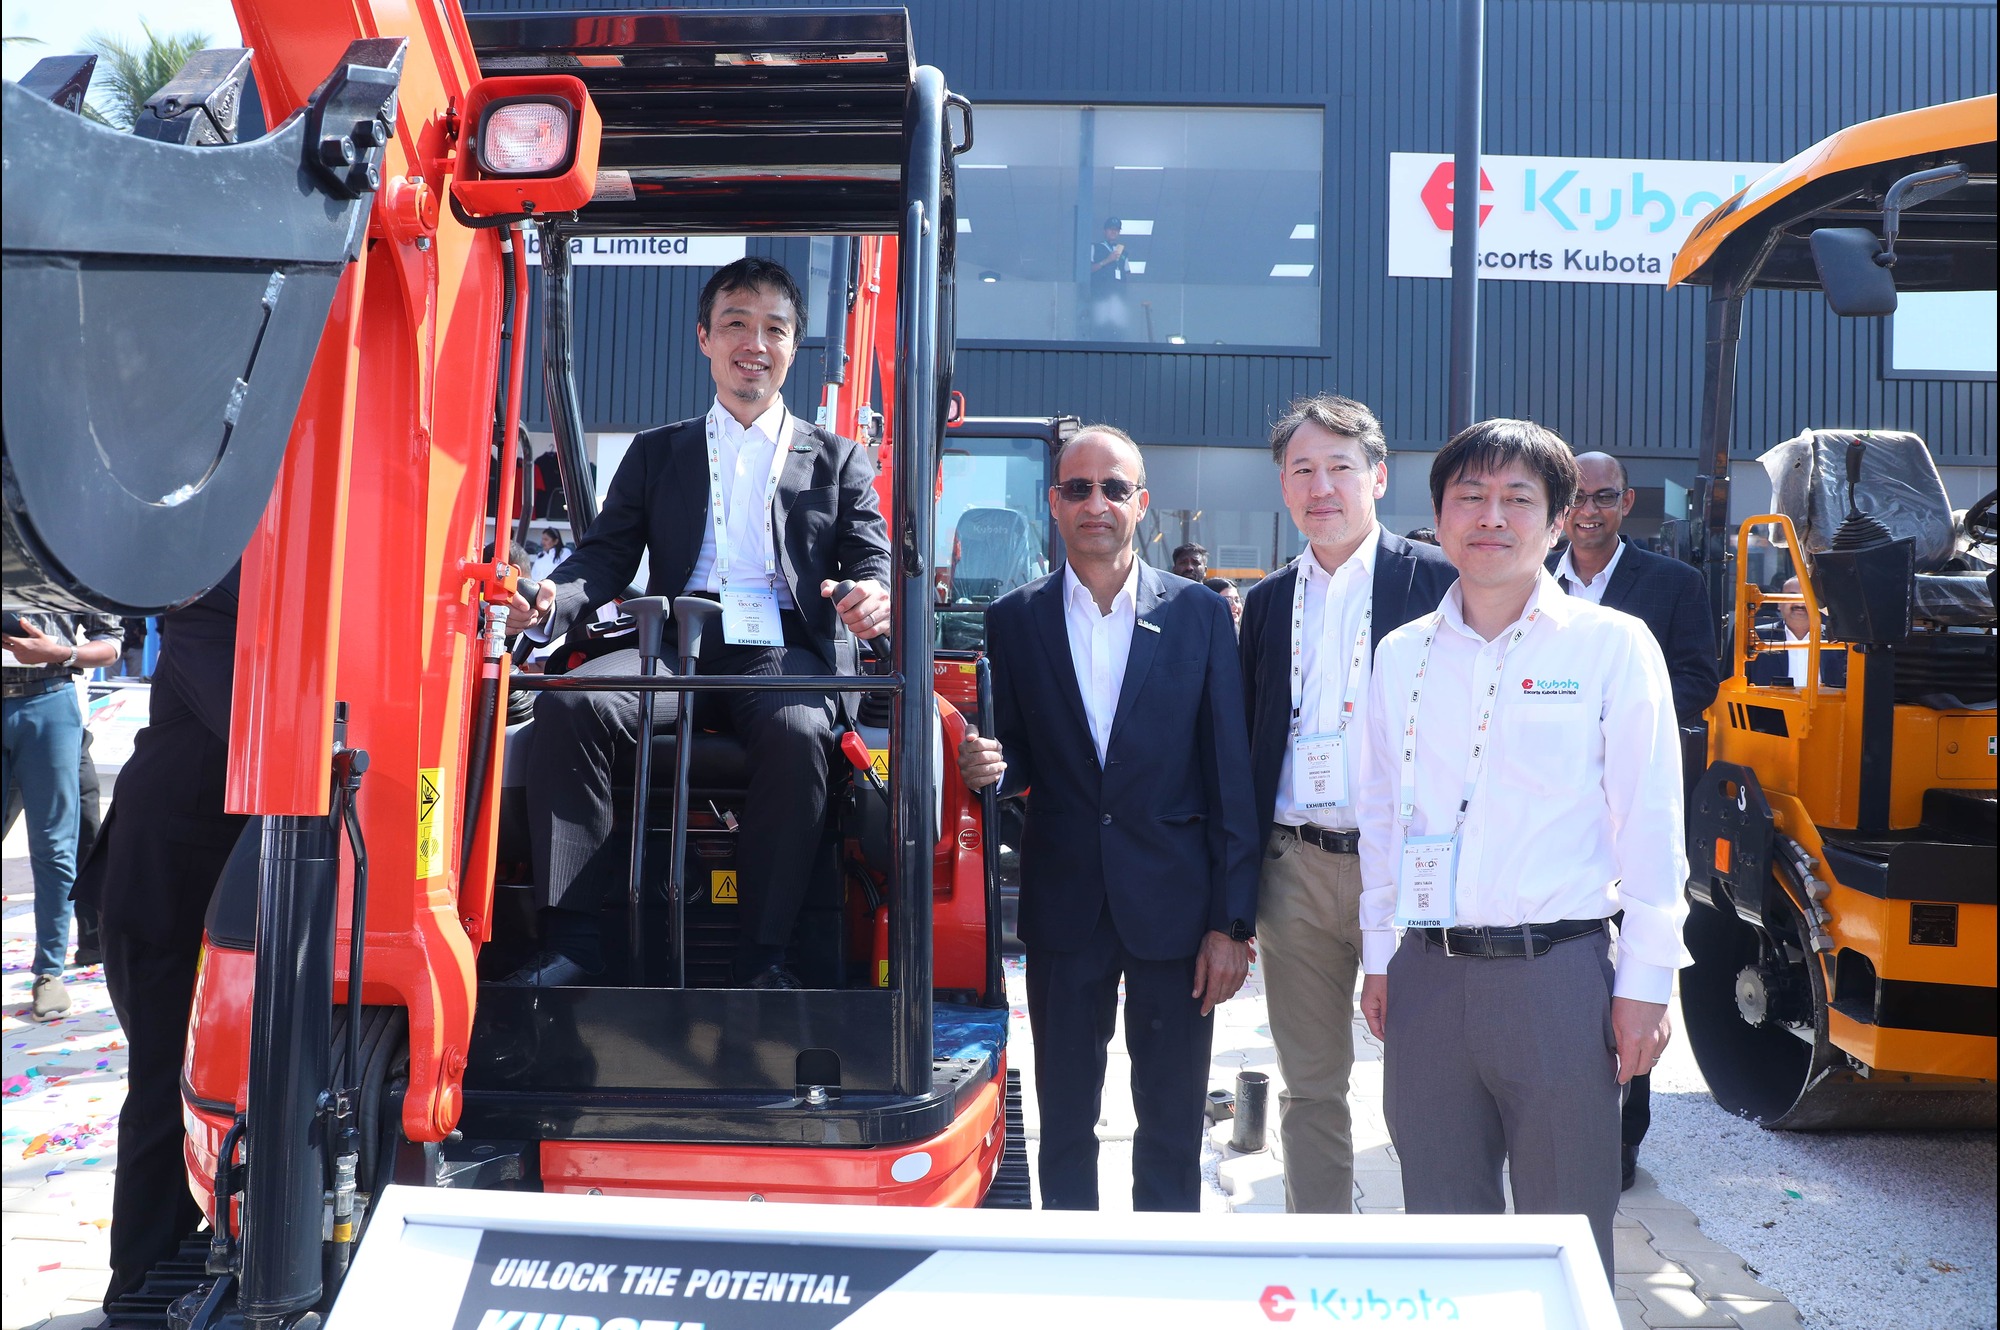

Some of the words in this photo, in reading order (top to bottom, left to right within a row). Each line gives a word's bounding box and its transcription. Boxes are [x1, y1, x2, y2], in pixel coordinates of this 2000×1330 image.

[593, 237, 689, 254] Limited
[1449, 246, 1553, 270] corts
[1563, 248, 1661, 274] Kubota
[973, 524, 1008, 534] Kubota
[1537, 679, 1579, 690] Kubota
[1305, 801, 1337, 809] EXHIBITOR
[1407, 919, 1441, 927] EXHIBITOR
[490, 1258, 619, 1293] UNLOCK
[620, 1265, 682, 1297] THE
[683, 1268, 852, 1305] POTENTIAL
[1310, 1288, 1460, 1321] Kubota
